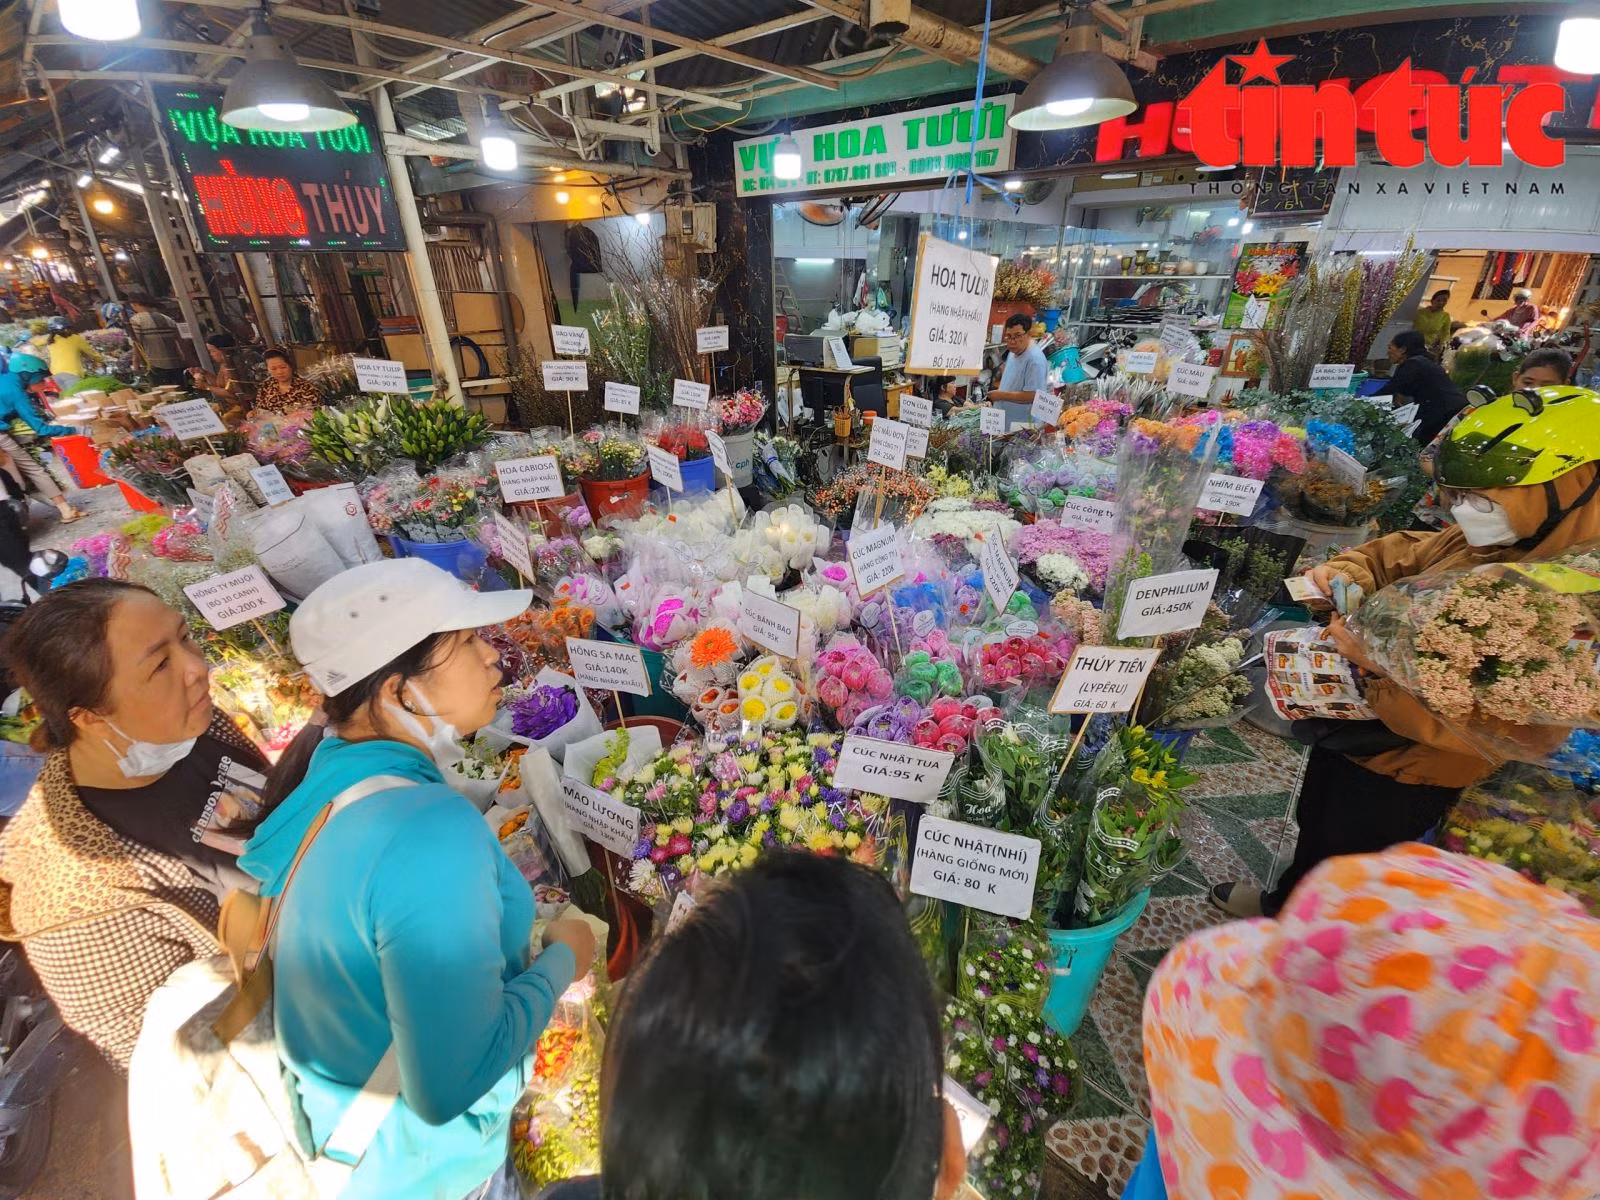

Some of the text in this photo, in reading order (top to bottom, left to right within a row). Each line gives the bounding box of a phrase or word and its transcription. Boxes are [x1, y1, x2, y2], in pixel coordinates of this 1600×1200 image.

[812, 123, 888, 161] HOA
[902, 102, 1007, 150] TƯƠI
[930, 264, 956, 291] HOA
[929, 325, 968, 346] GIÁ: 320 K
[499, 461, 555, 476] HOA CABIOSA
[1208, 478, 1234, 490] NHÍM
[1065, 500, 1115, 519] Cúc công ty
[865, 533, 897, 555] MAGNUM
[1135, 580, 1210, 602] DENPHILIUM
[1140, 600, 1193, 618] GIÁ:450K
[599, 650, 613, 660] SA
[615, 652, 639, 665] MẠC
[1074, 654, 1147, 674] THÚY TIÊN
[585, 662, 629, 675] GIÁ:140K
[1078, 681, 1128, 696] (LYPÊRU)
[1073, 698, 1117, 710] GIÁ: 60 K
[852, 744, 940, 769] CÚC NHẬT TUA
[862, 762, 926, 784] GIÁ:95 K
[563, 785, 635, 830] MAO LƯƠNG
[923, 827, 1028, 866] CÚC NHẬT(NHÍ)
[916, 846, 1030, 885] (HÀNG GIỐNG MỚI)
[933, 867, 998, 896] GIÁ: 80 K
